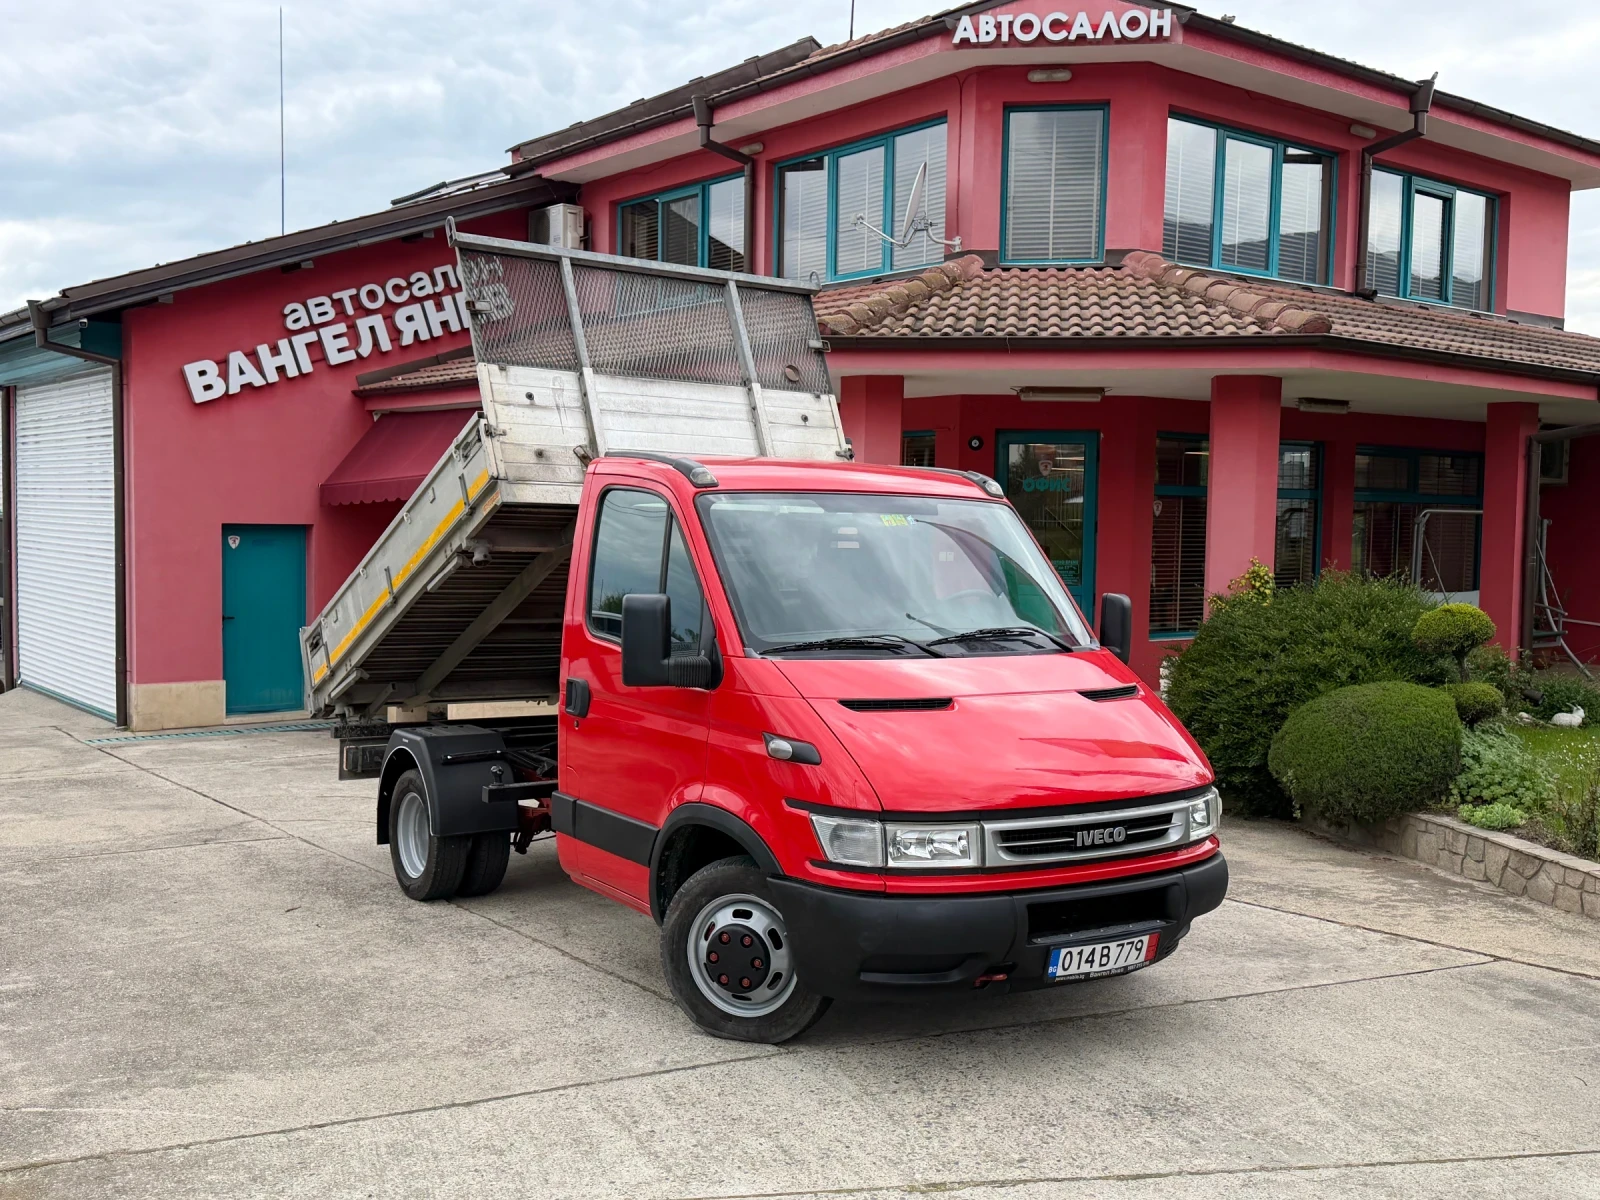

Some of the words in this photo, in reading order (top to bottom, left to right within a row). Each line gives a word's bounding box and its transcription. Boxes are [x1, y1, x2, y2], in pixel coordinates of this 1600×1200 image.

[952, 8, 1172, 45] АВТОСАЛОН
[182, 313, 393, 404] ВАНГЕЛ
[1023, 477, 1072, 492] ОФИС
[1076, 826, 1126, 847] IVECO
